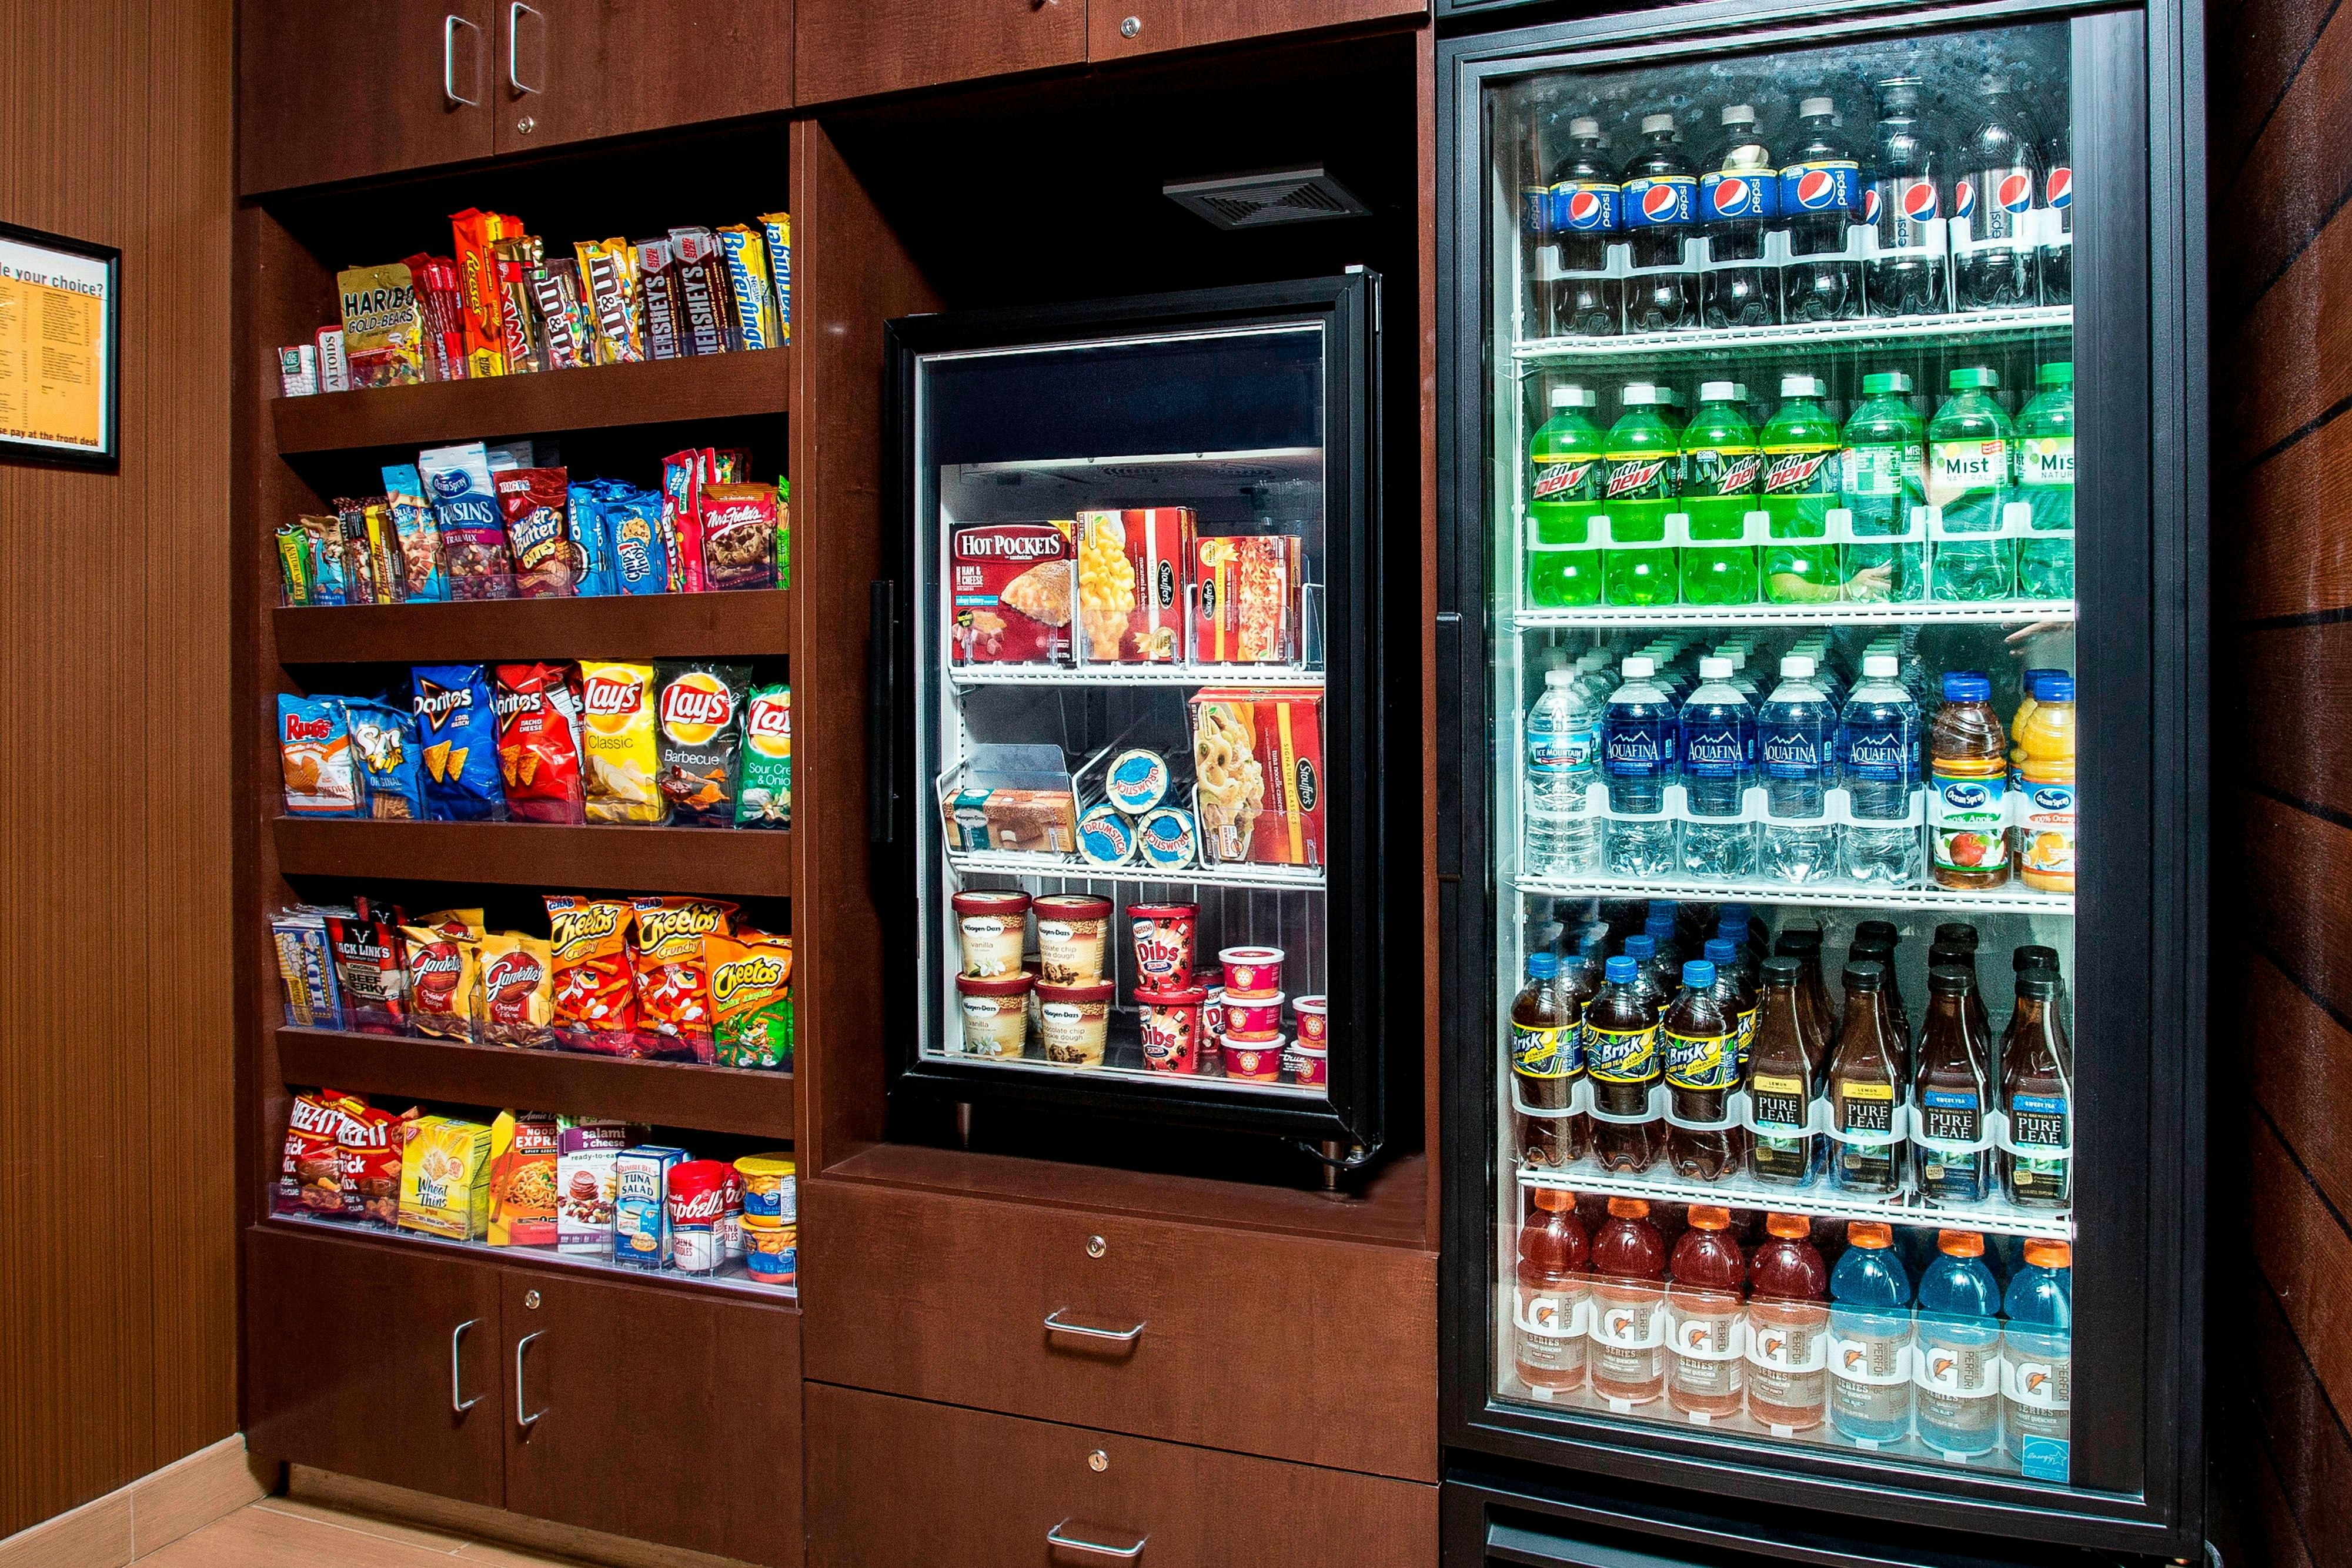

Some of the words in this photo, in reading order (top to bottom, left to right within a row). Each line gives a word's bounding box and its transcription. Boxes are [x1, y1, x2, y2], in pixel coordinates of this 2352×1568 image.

[1837, 169, 1848, 206] pepsi
[1678, 185, 1689, 220] pepsi
[1750, 178, 1762, 213] pepsi
[1601, 193, 1612, 228] pepsi
[16, 268, 47, 284] your
[52, 275, 103, 296] choice?
[465, 250, 481, 316] Reese's
[723, 232, 766, 350] Butterfinge
[344, 285, 416, 317] HARIBO
[11, 429, 25, 439] pay
[28, 430, 37, 439] at
[39, 432, 54, 440] the
[56, 433, 78, 444] front
[80, 437, 99, 447] desk
[1946, 457, 1989, 474] Mist
[962, 535, 992, 556] HOT
[994, 533, 1061, 556] POCKETS
[961, 566, 975, 575] HAM
[961, 575, 984, 586] CHEESE
[497, 692, 540, 715] oritos
[588, 735, 634, 750] Classic
[664, 749, 720, 765] Barbecue
[1536, 748, 1546, 757] ICE
[1546, 748, 1582, 758] MOUNTAIN
[1607, 740, 1659, 761] AQUAFINA
[1688, 740, 1743, 762] AQUAFINA
[1763, 741, 1818, 764] AQUAFINA
[1850, 742, 1906, 764] AQUAFINA
[749, 763, 771, 775] Sour
[766, 775, 790, 785] Onio
[1947, 791, 1966, 804] Ocean
[1966, 793, 1985, 805] Spray
[2036, 794, 2053, 806] Ocean
[2053, 795, 2070, 808] Spray
[1084, 821, 1126, 855] DRUMSTICK
[656, 940, 700, 959] Crunchy
[1054, 952, 1075, 960] dough
[1061, 945, 1077, 954] chip
[1137, 941, 1180, 962] Dibs
[713, 959, 781, 1002] Cheetos
[1061, 1034, 1083, 1042] dough
[1069, 1027, 1085, 1037] chip
[1602, 1035, 1643, 1062] Brisk
[1670, 1043, 1709, 1065] Brisk
[1759, 1096, 1798, 1112] PURE
[1847, 1104, 1889, 1118] PURE
[1759, 1109, 1795, 1123] LEAF
[1847, 1116, 1886, 1129] LEAF
[1930, 1113, 1973, 1128] PURE
[1930, 1125, 1970, 1139] LEAF
[2018, 1118, 2062, 1133] PURE
[582, 1128, 626, 1139] salami
[2018, 1130, 2059, 1144] LEAF
[590, 1138, 625, 1148] cheese
[418, 1176, 448, 1197] Wheat
[625, 1174, 651, 1186] TUNA
[622, 1184, 654, 1197] SALAD
[415, 1193, 447, 1208] Thins
[1679, 1358, 1713, 1371] SERIES
